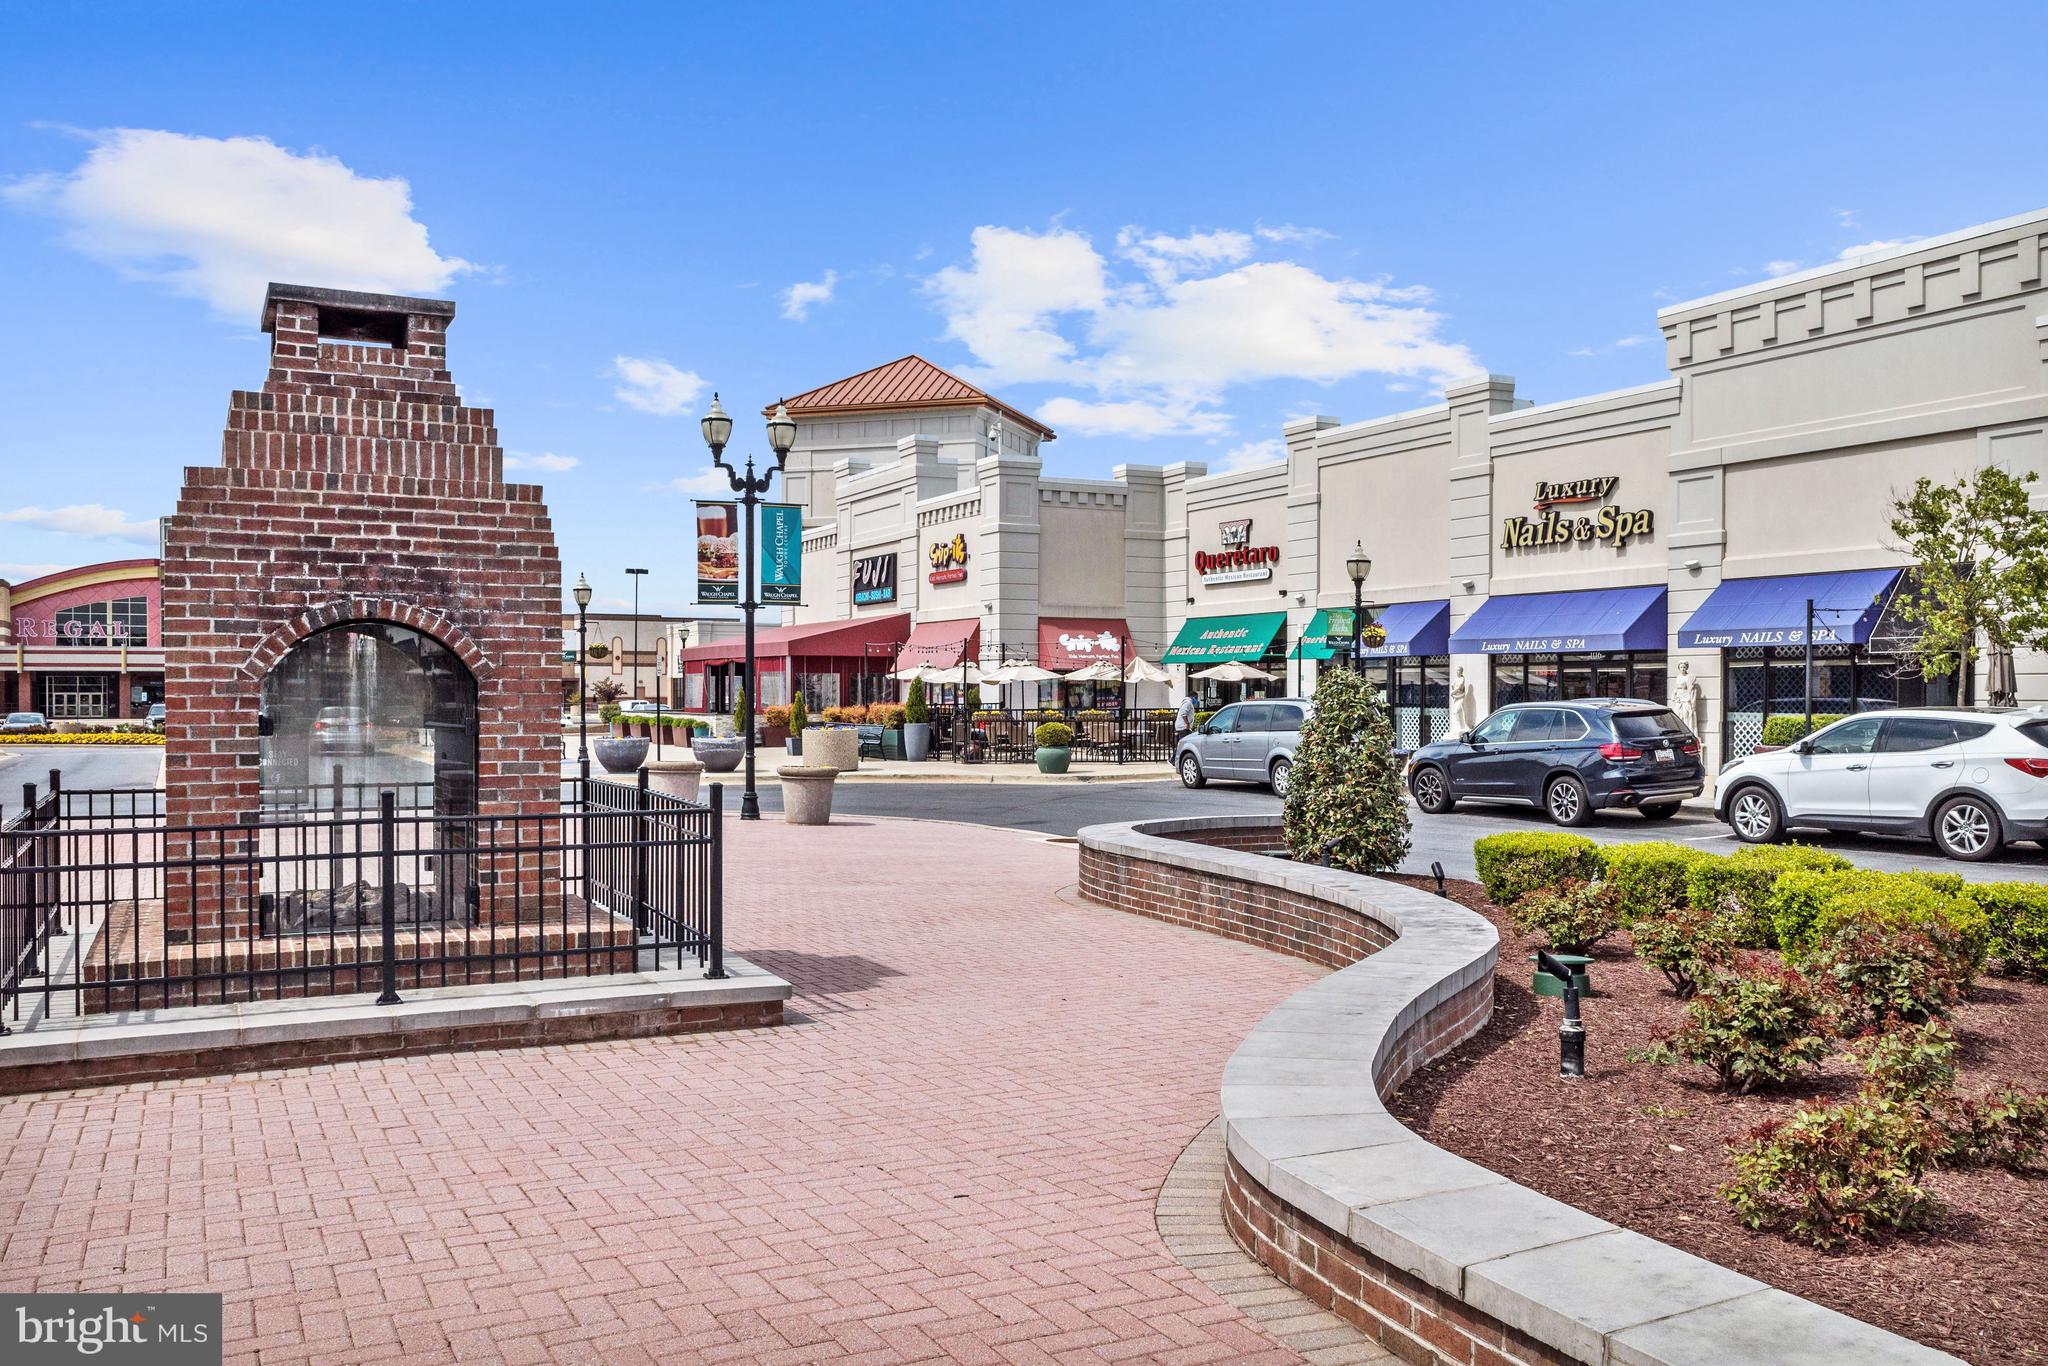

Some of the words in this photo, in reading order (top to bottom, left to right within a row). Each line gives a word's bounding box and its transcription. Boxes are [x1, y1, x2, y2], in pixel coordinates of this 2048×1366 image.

[1534, 476, 1617, 503] Luxury
[774, 510, 784, 546] CHAPEL
[1501, 511, 1570, 549] Nails
[1573, 518, 1594, 541] &
[1596, 504, 1653, 547] Spa
[774, 547, 784, 582] WAUGH
[1195, 543, 1279, 576] Querétaro
[852, 555, 890, 588] FUJI
[16, 617, 129, 638] REGAL
[1199, 627, 1249, 641] Authentic
[1694, 634, 1732, 646] Luxury
[1740, 632, 1784, 643] NAILS
[1789, 630, 1803, 641] &
[1810, 629, 1836, 641] SPA
[1169, 644, 1208, 657] Mexican
[1208, 641, 1264, 656] Restaurant
[1396, 643, 1408, 654] SPA
[1481, 642, 1511, 652] Luxury
[1515, 640, 1547, 650] NAILS
[1551, 640, 1562, 649] &
[1565, 639, 1586, 649] SPA
[269, 750, 287, 759] STAY
